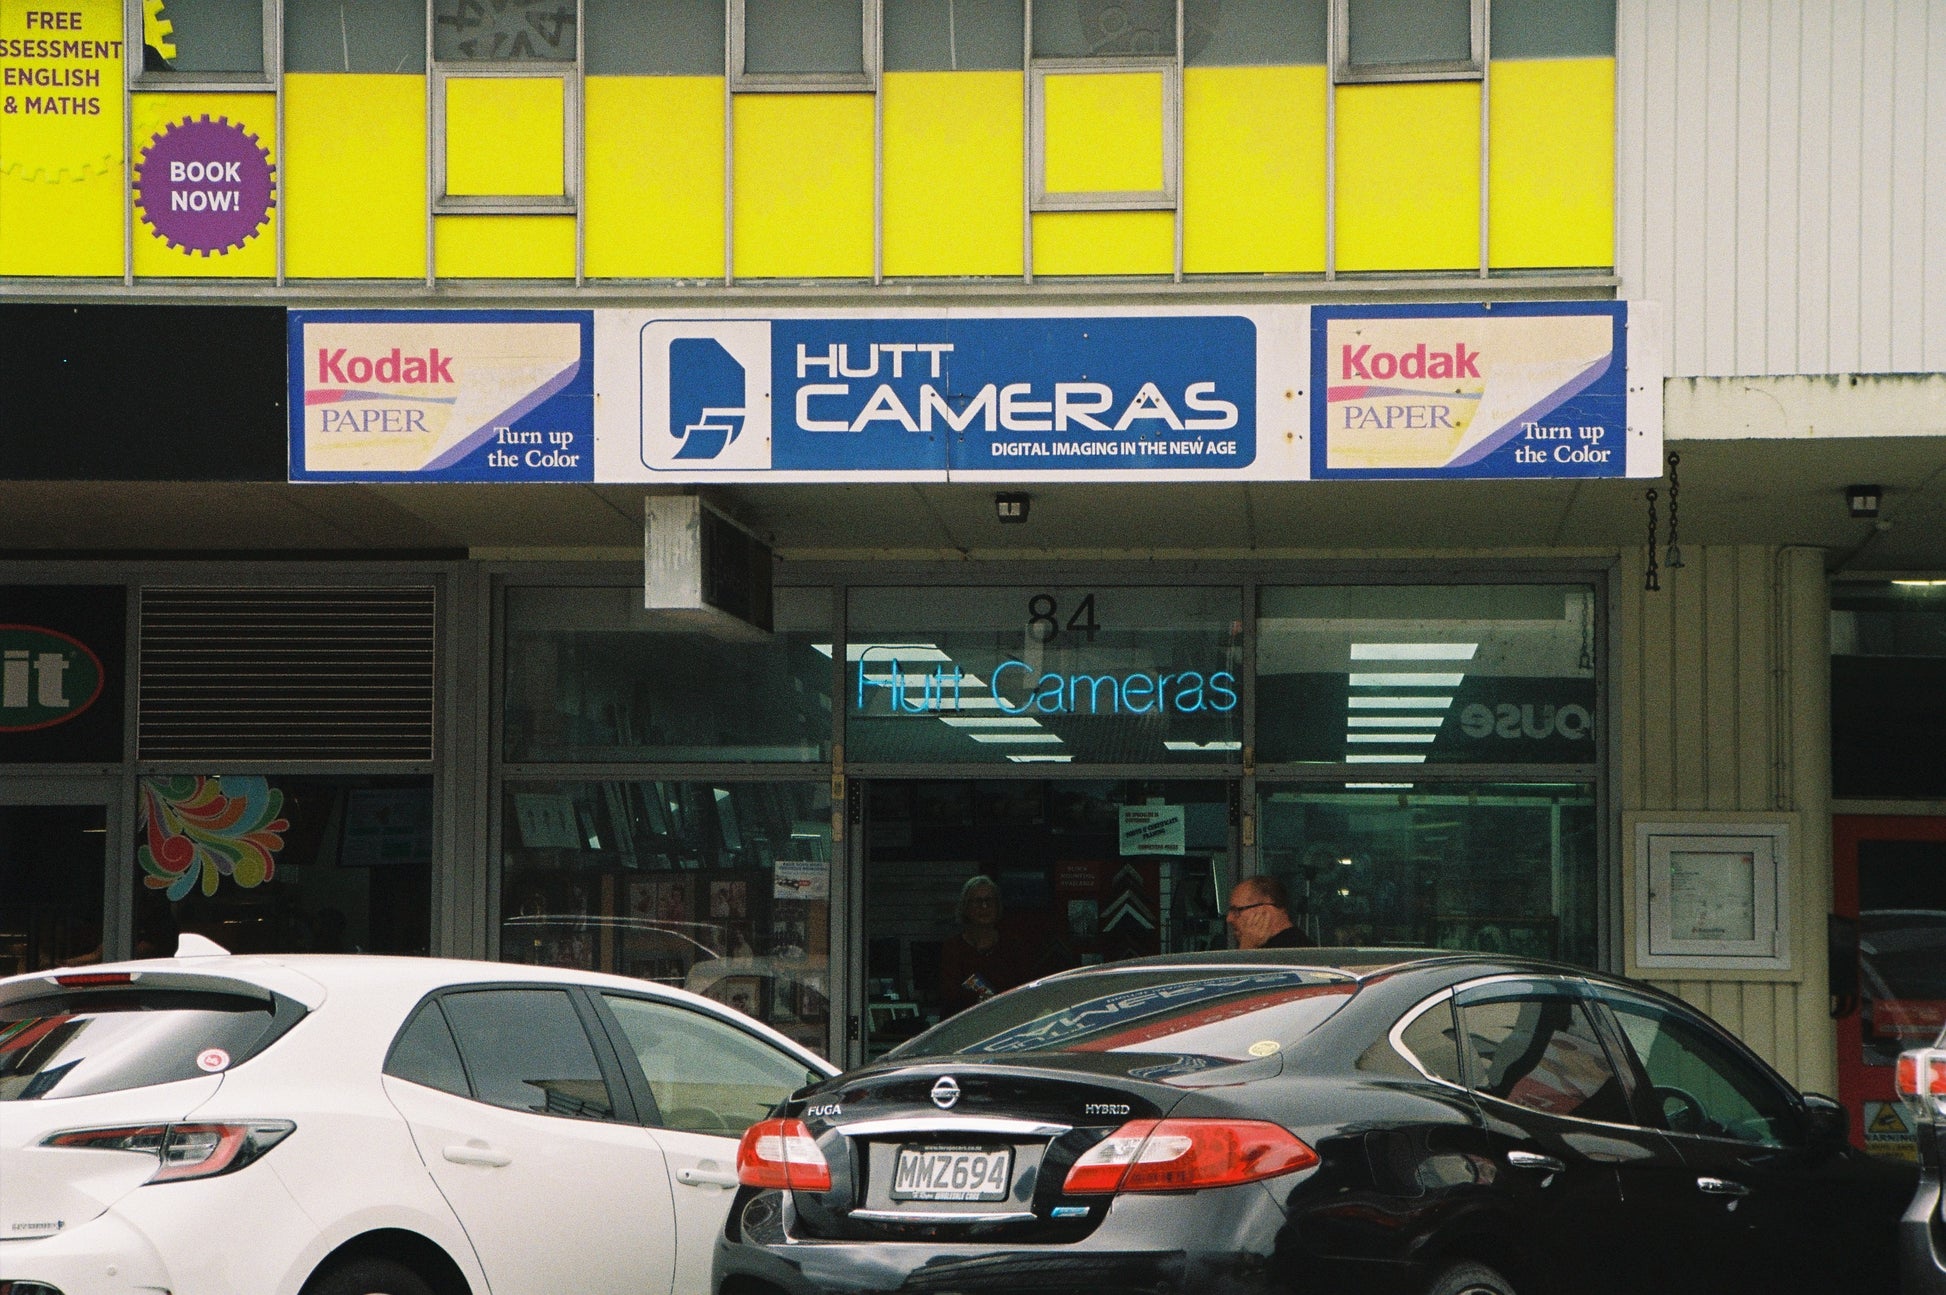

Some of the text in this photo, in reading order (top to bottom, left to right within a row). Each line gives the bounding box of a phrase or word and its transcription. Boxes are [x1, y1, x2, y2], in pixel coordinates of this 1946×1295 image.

[26, 11, 82, 30] FREE
[0, 40, 122, 59] SSESSMENT
[4, 68, 100, 87] ENGLISH
[4, 96, 101, 115] & MATHS
[170, 161, 241, 182] BOOK
[171, 191, 240, 211] NOW!
[318, 348, 455, 384] Kodak
[796, 343, 954, 378] HUTT
[1342, 343, 1481, 380] Kodak
[796, 382, 1238, 432] CAMERAS
[1343, 405, 1455, 430] PAPER
[321, 409, 430, 433] PAPER
[493, 427, 574, 450] Turn up
[1521, 422, 1605, 444] Turn up
[992, 440, 1237, 456] DIGITAL IMAGING IN THE NEW AGE
[1515, 445, 1611, 463] the Color
[488, 450, 580, 468] the Color
[1027, 593, 1101, 644] 84
[856, 657, 1238, 715] Hutt Cameras
[808, 1104, 842, 1116] FUGA
[1085, 1104, 1130, 1115] HYBRID
[897, 1155, 1006, 1190] MMZ694
